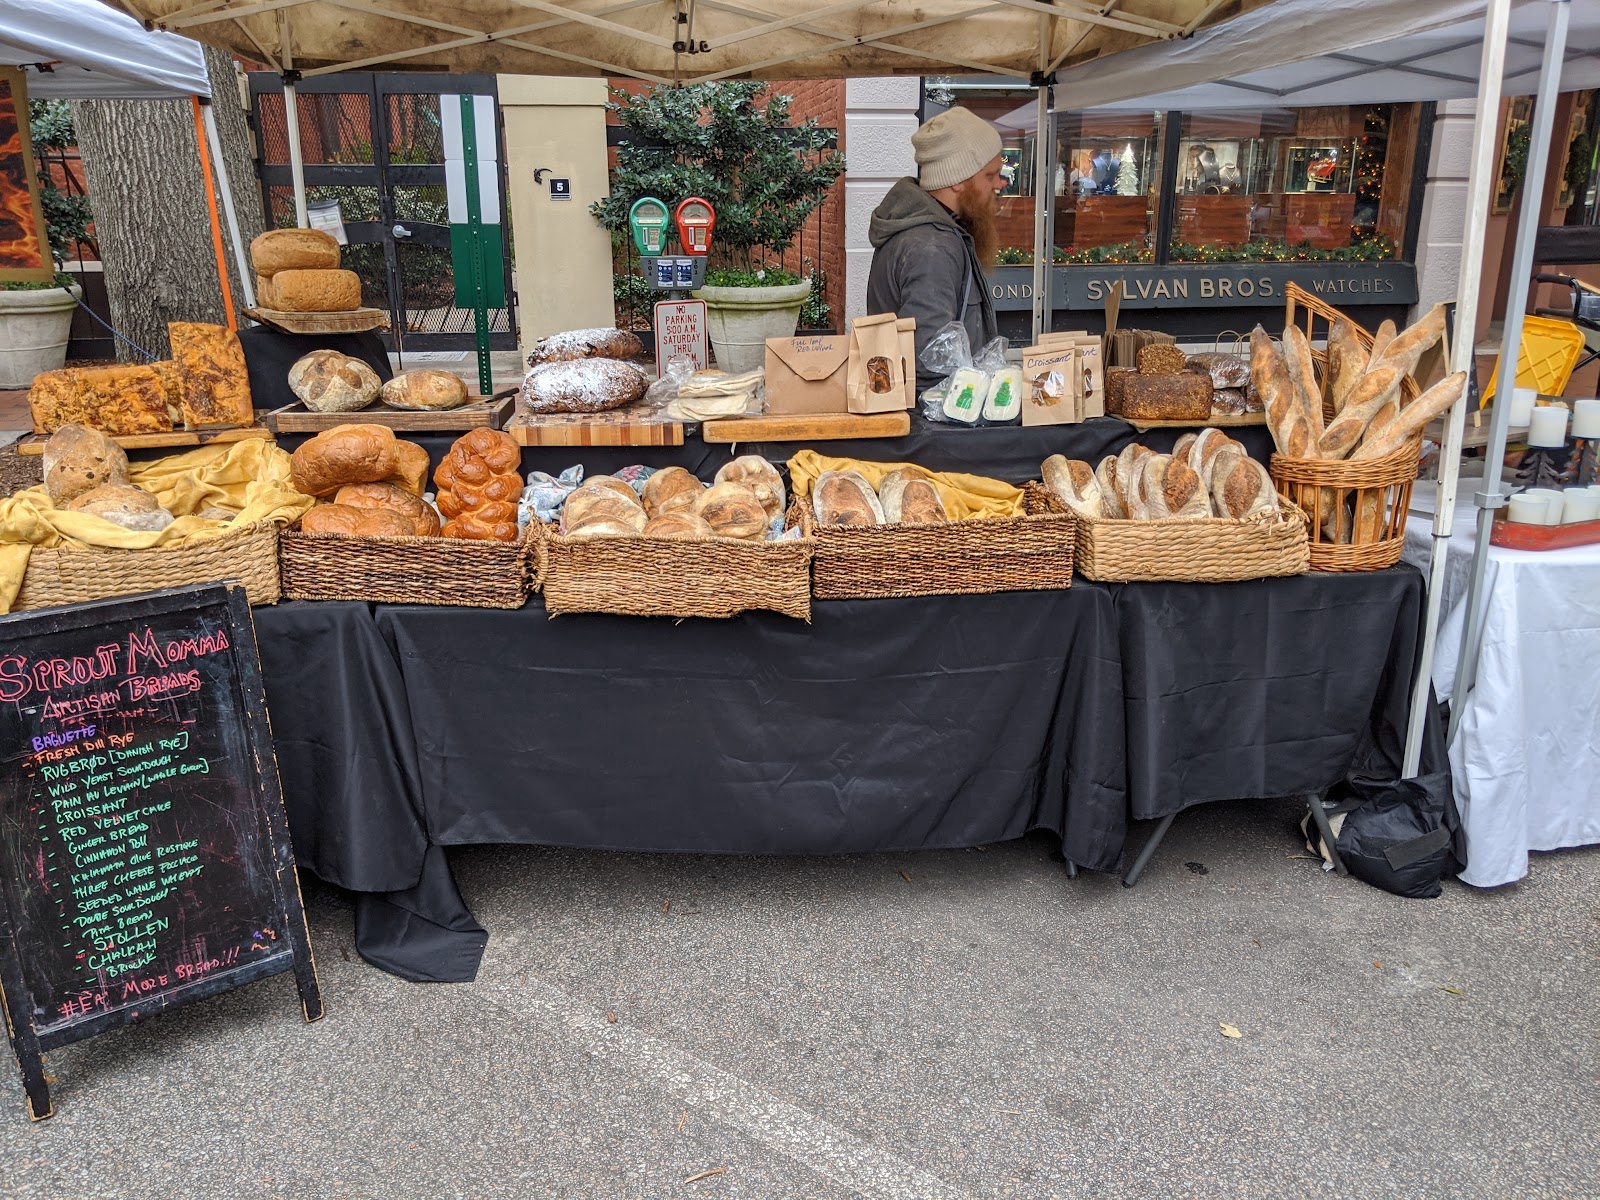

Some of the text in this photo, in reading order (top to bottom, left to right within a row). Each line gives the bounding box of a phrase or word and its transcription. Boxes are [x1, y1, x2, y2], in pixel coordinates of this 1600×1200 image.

[556, 182, 565, 192] 5
[1087, 277, 1282, 300] SYLVAN BROS.
[1312, 279, 1395, 294] WATCHES
[665, 314, 698, 325] PARKING
[675, 305, 686, 314] NO
[663, 333, 701, 345] SATURDAY
[666, 324, 698, 335] 5:00 A.M.
[673, 344, 692, 354] THRU
[1027, 352, 1072, 369] Croissant
[0, 628, 230, 702] SPROUT MOMMA
[40, 669, 202, 722] ARTISAN BREADS
[32, 724, 97, 752] BAGUETTE
[34, 745, 81, 764] FRESH
[108, 732, 135, 748] RYE
[48, 754, 172, 798] WILD YEAST SOURDOUGH
[51, 796, 82, 813] PAIN
[57, 798, 128, 824] CROISSANT
[58, 801, 172, 842] RED VELVET CAKE
[68, 822, 149, 854] GINGER BREAD
[75, 843, 126, 868] CINNAMON
[72, 880, 109, 900] THREE
[114, 865, 155, 886] CHEESE
[78, 865, 204, 913] SEEDED WHOLE WHEAT
[94, 916, 169, 951] STOLLEN
[122, 974, 168, 999] MORE
